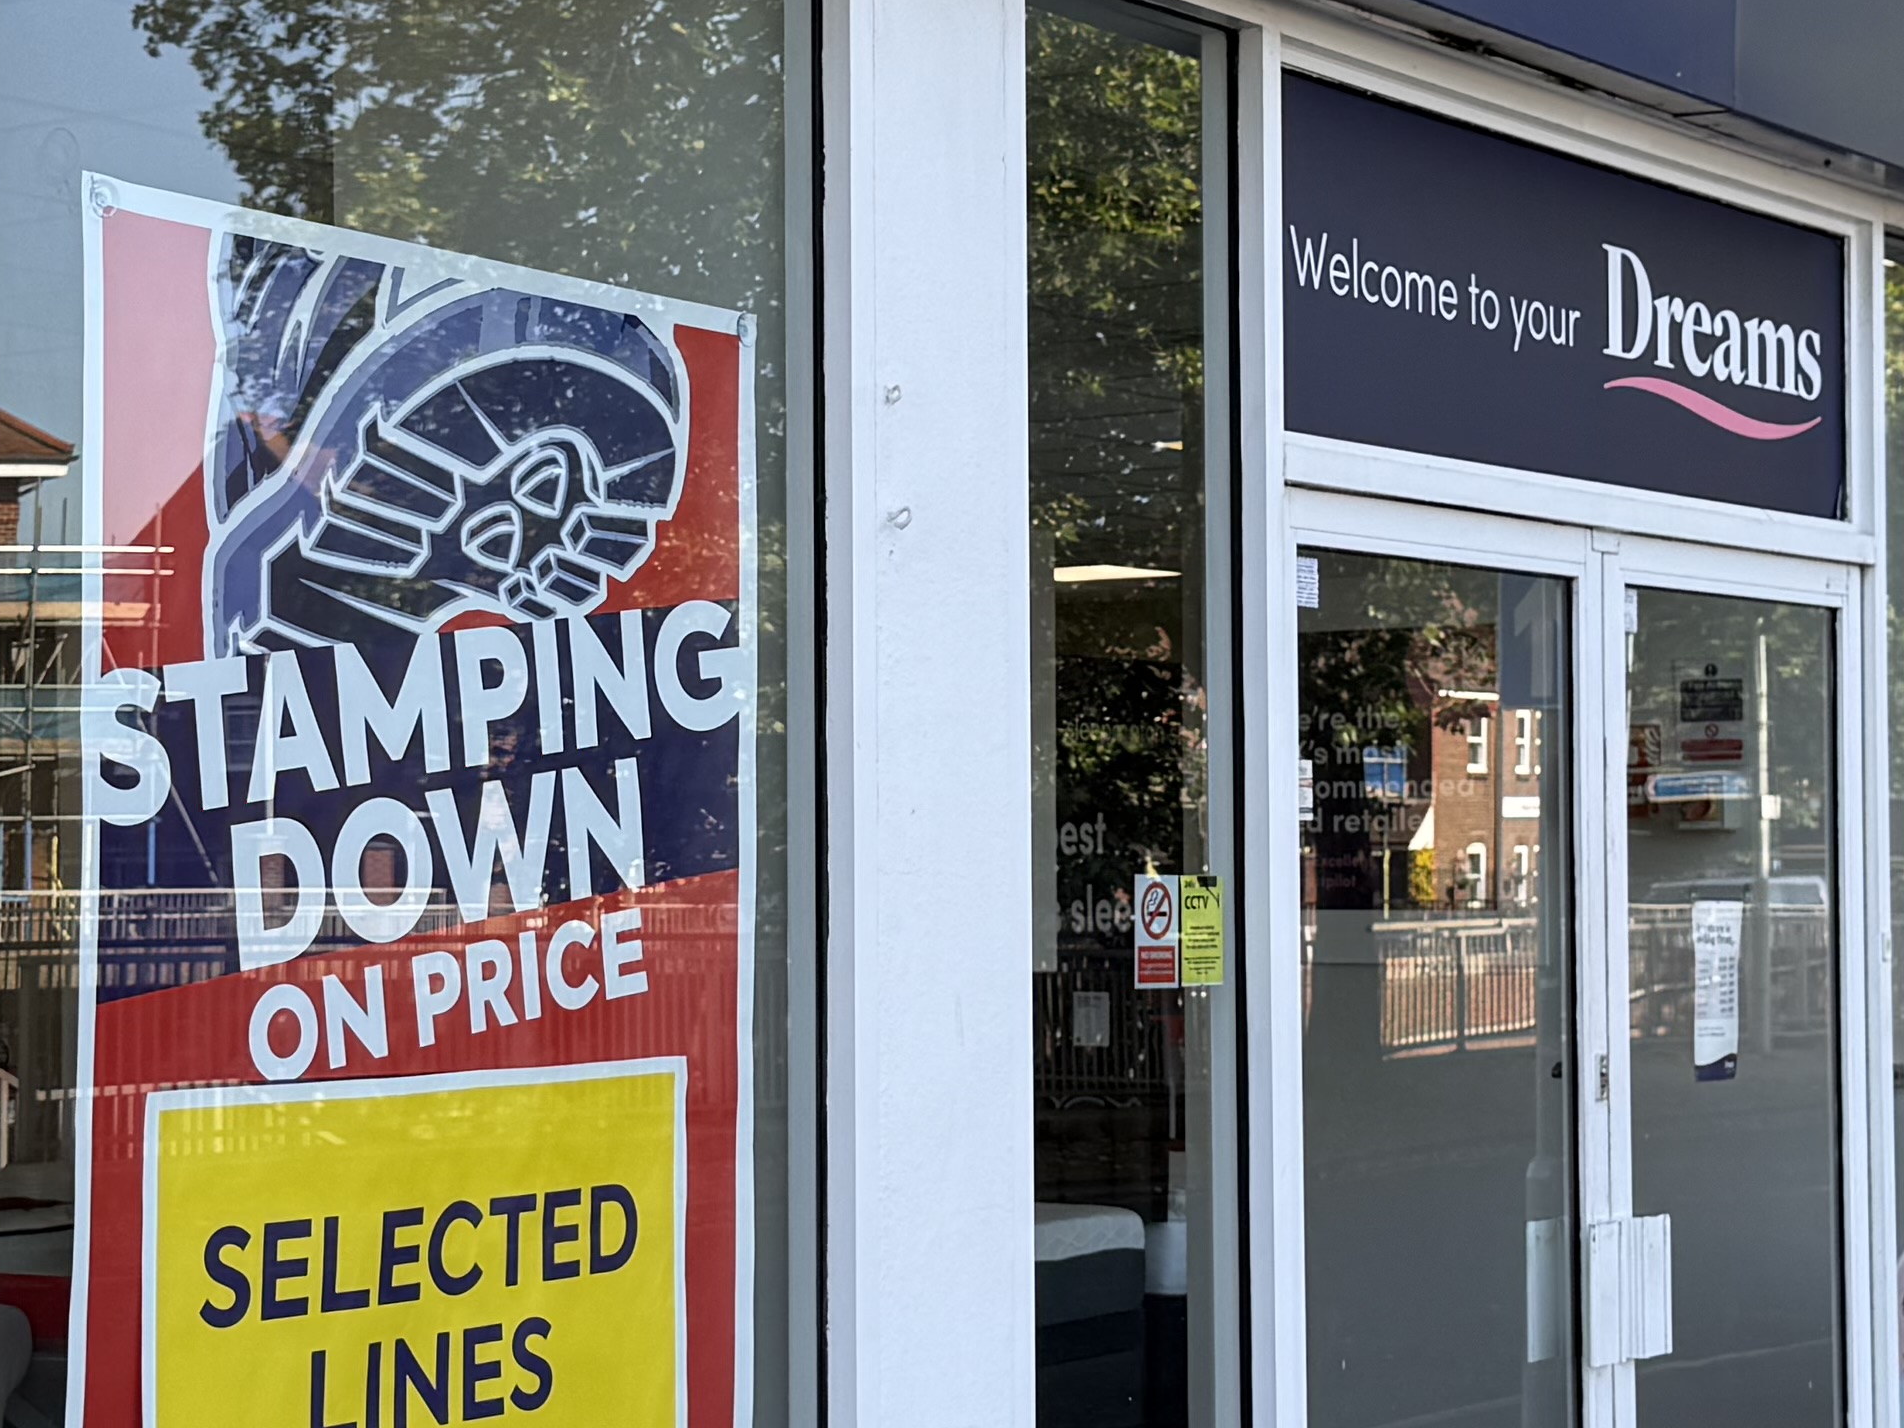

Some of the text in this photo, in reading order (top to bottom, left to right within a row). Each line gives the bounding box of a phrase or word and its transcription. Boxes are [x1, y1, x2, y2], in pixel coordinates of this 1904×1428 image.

[1290, 224, 1822, 401] Welcome to your Dreams
[80, 599, 741, 827] STAMPING
[231, 758, 646, 974] DOWN
[1070, 883, 1134, 935] slee
[1184, 895, 1209, 910] CCTV
[247, 909, 649, 1080] ON PRICE
[199, 1183, 639, 1329] SELECTED
